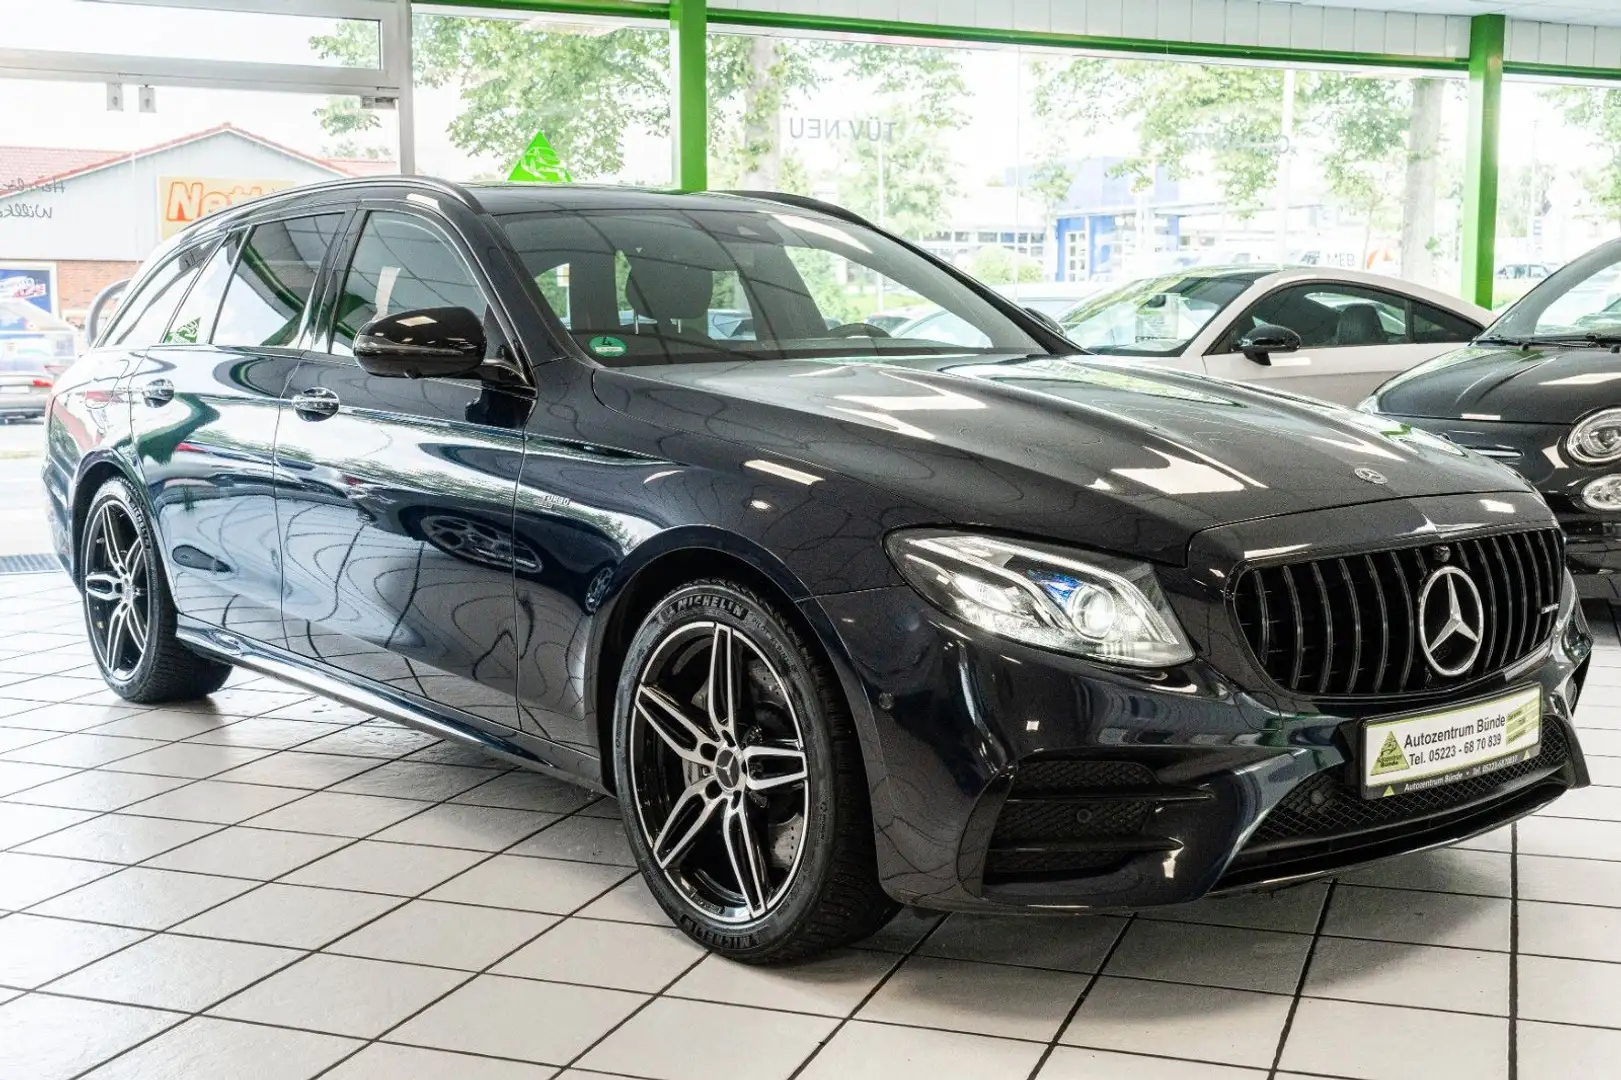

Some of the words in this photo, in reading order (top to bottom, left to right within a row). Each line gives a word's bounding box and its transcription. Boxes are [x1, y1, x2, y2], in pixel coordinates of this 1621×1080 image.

[677, 594, 745, 618] MICHELIN
[1403, 724, 1475, 749] Autozentrum
[1476, 714, 1506, 733] Bünde
[1409, 752, 1426, 766] Tel.
[1428, 745, 1457, 762] 05223
[1463, 740, 1475, 754] 68
[1476, 737, 1487, 751] 70
[1487, 733, 1502, 748] 839
[1403, 778, 1444, 792] Autozentrum
